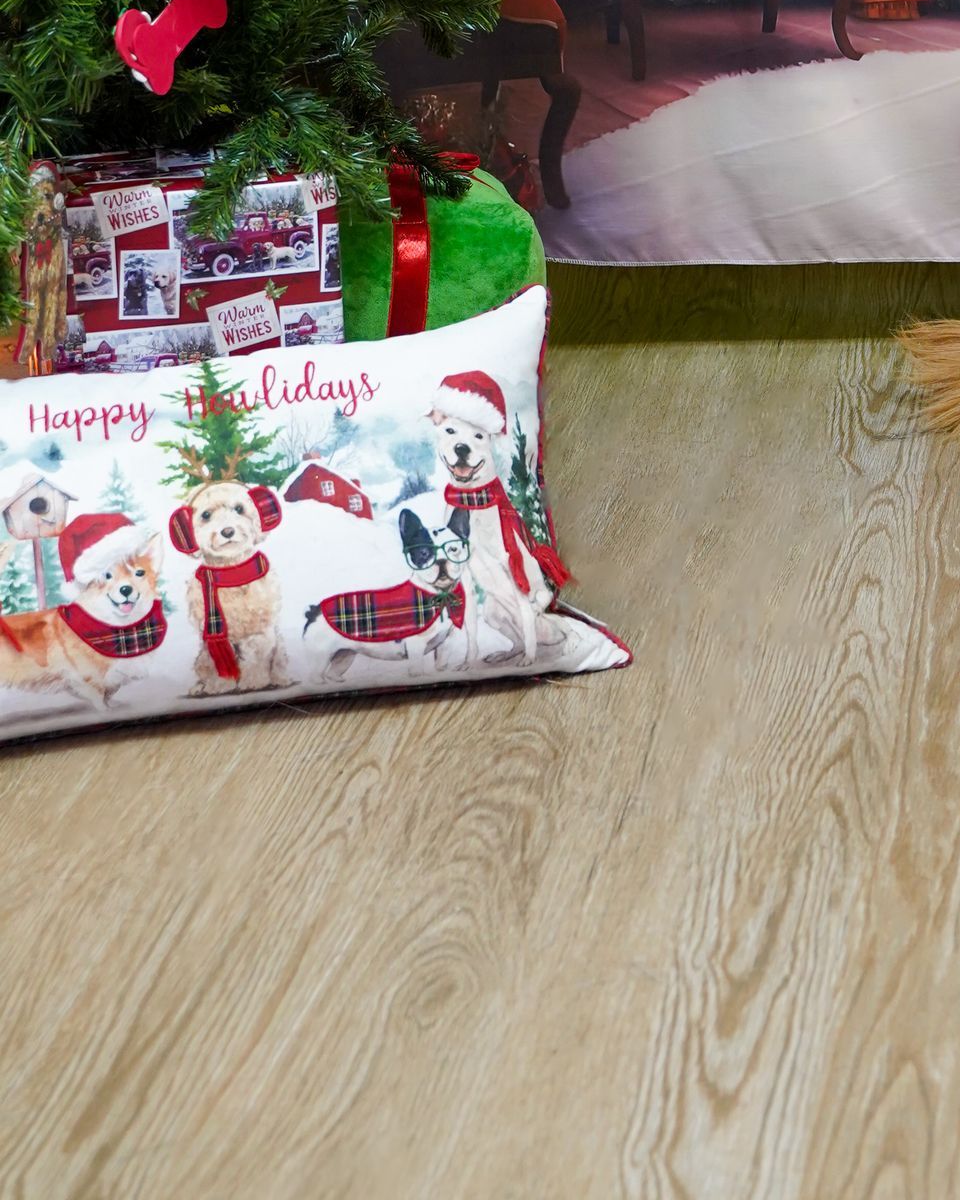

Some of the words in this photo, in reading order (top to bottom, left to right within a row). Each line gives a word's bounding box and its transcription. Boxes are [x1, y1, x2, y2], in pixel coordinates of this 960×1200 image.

[103, 190, 152, 209] Warm
[310, 187, 336, 205] WIS
[107, 205, 160, 231] WISHES
[218, 304, 265, 325] Warm
[221, 320, 273, 346] WISHES
[28, 401, 156, 443] Happy
[183, 360, 381, 421] Howlidays
